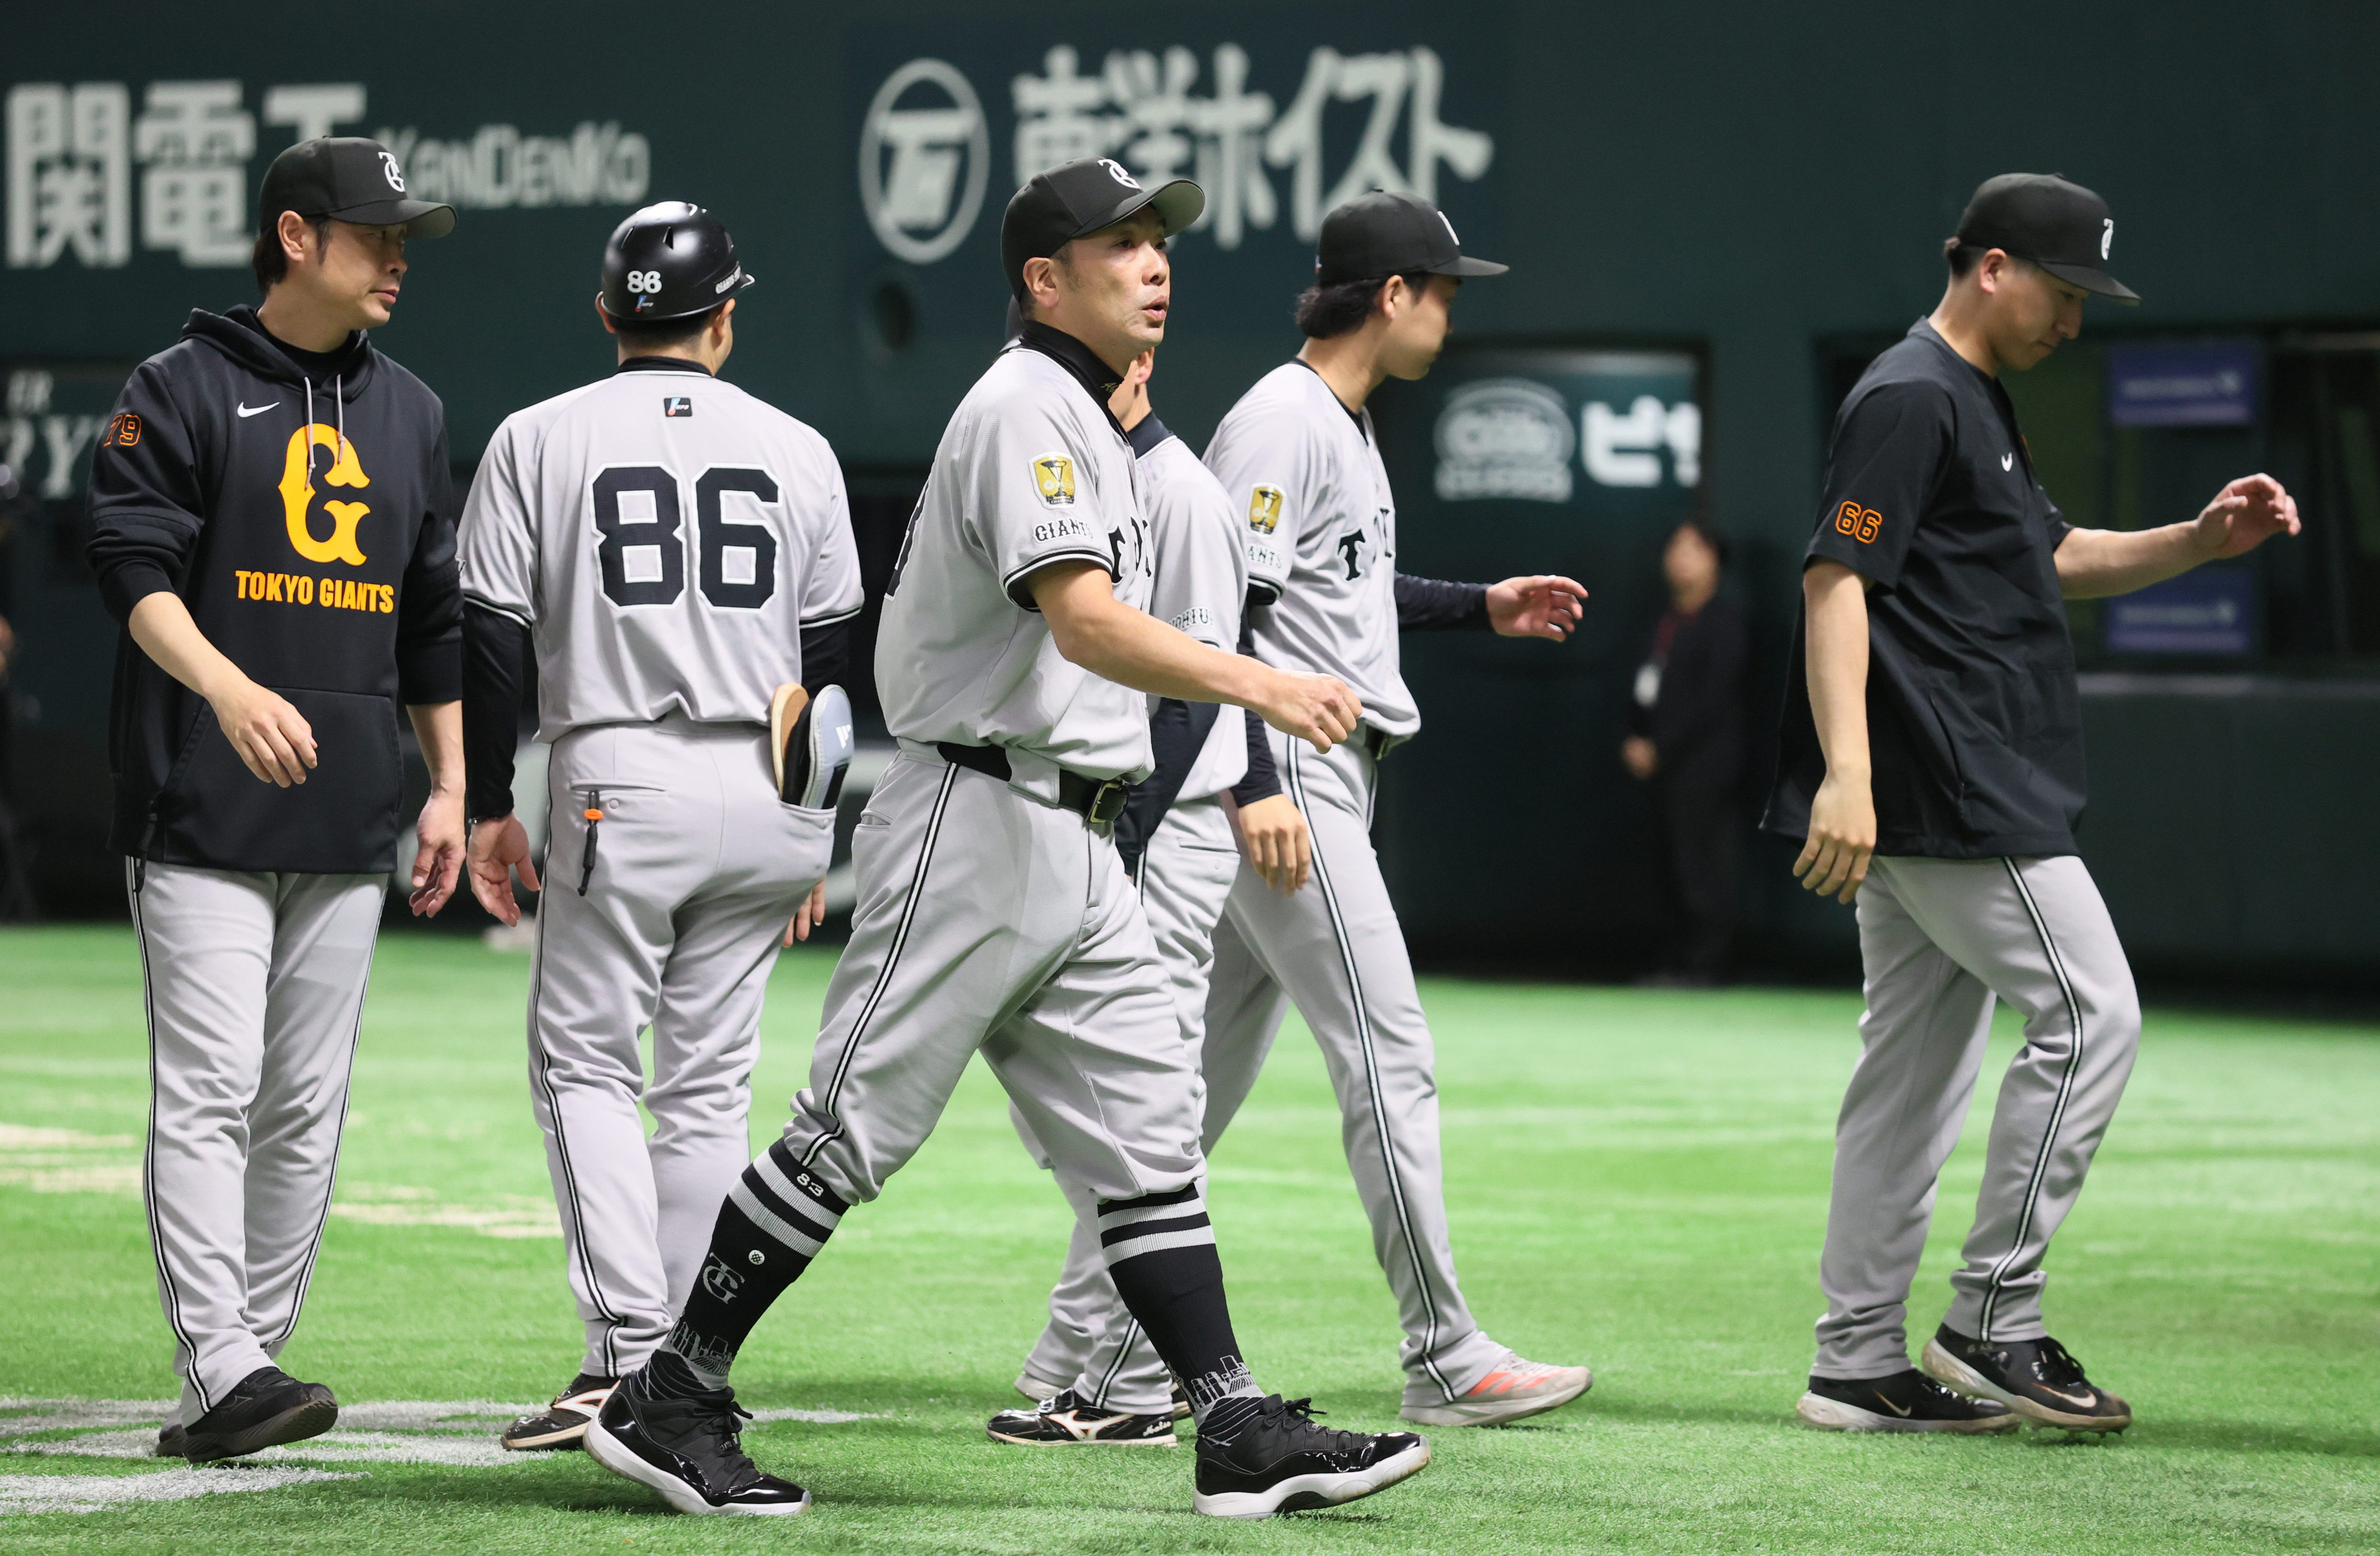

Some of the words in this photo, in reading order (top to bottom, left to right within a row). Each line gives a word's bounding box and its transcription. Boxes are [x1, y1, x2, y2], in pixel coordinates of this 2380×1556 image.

[627, 270, 662, 294] 86
[103, 414, 142, 447] 79
[278, 423, 371, 567] G
[587, 461, 783, 612] 86
[1034, 518, 1094, 542] GIANTS
[1835, 500, 1882, 544] 66
[1248, 545, 1283, 570] ANTS
[235, 570, 314, 605] TOKYO
[319, 578, 394, 614] GIANTS
[796, 1173, 824, 1197] 83
